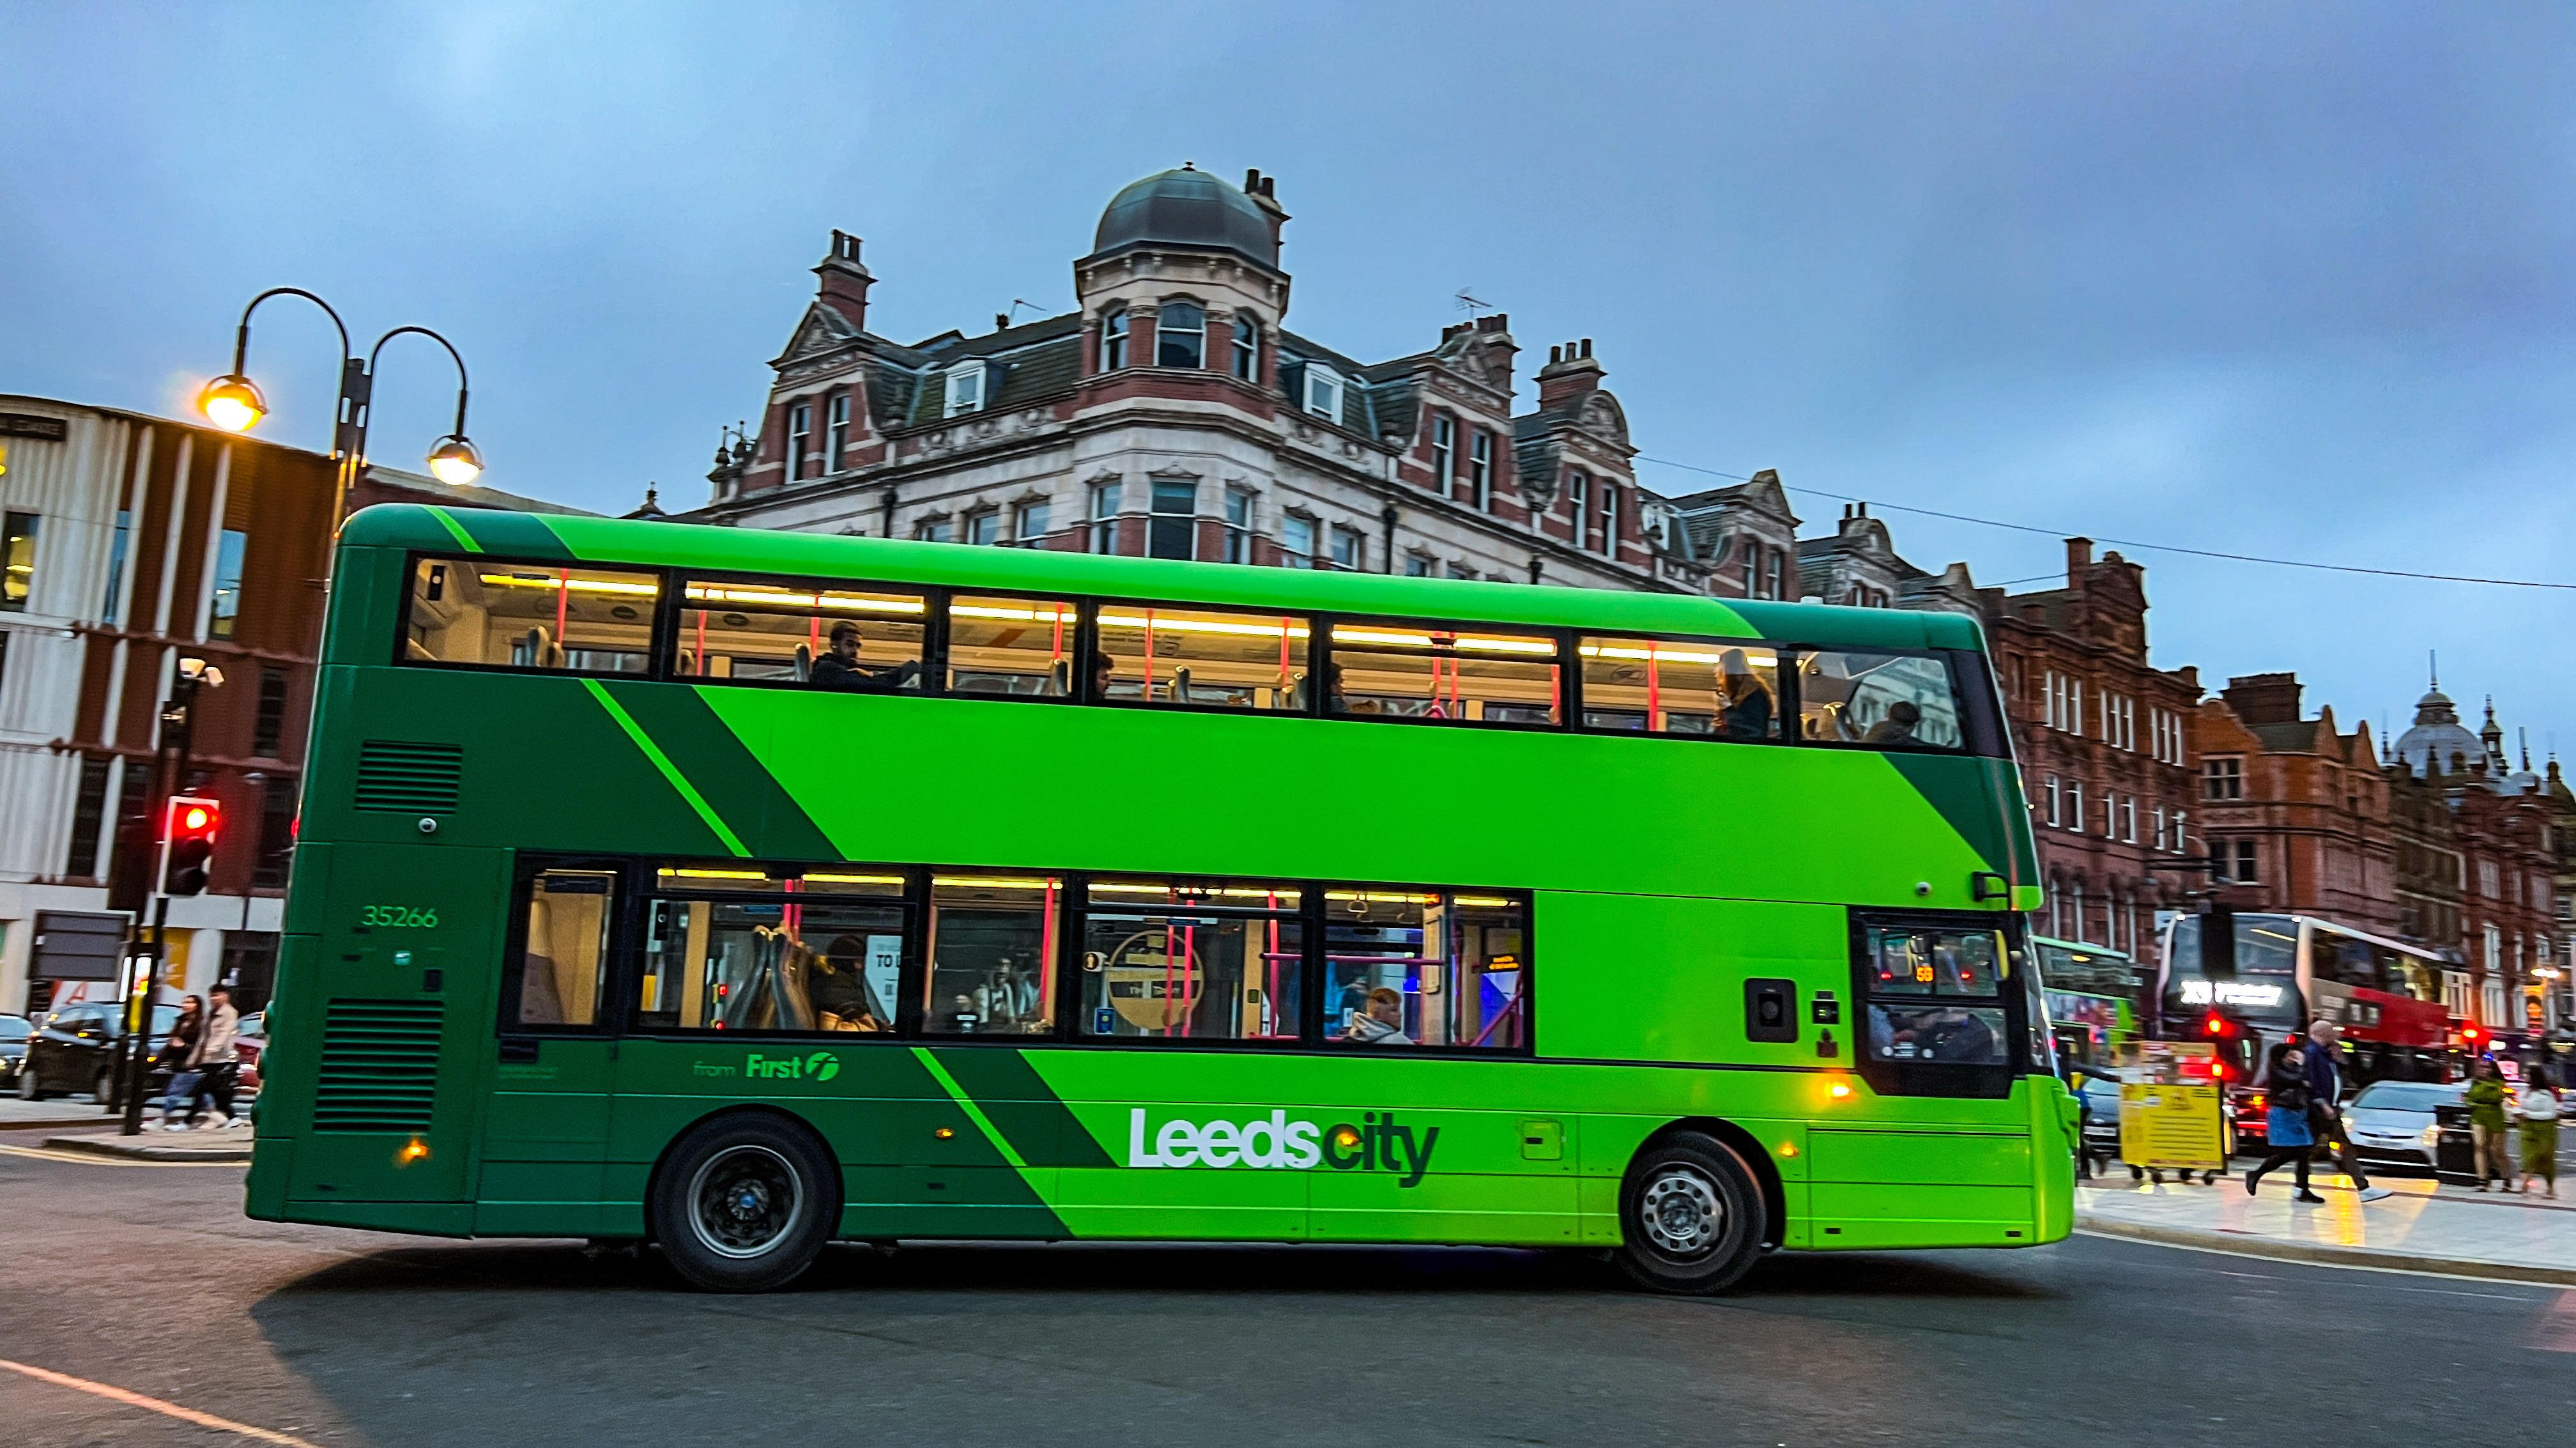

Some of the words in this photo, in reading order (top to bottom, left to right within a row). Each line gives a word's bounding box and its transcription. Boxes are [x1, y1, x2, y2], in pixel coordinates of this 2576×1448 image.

[361, 905, 438, 928] 35266
[877, 954, 893, 967] TO
[693, 1061, 735, 1077] from
[746, 1054, 801, 1079] First
